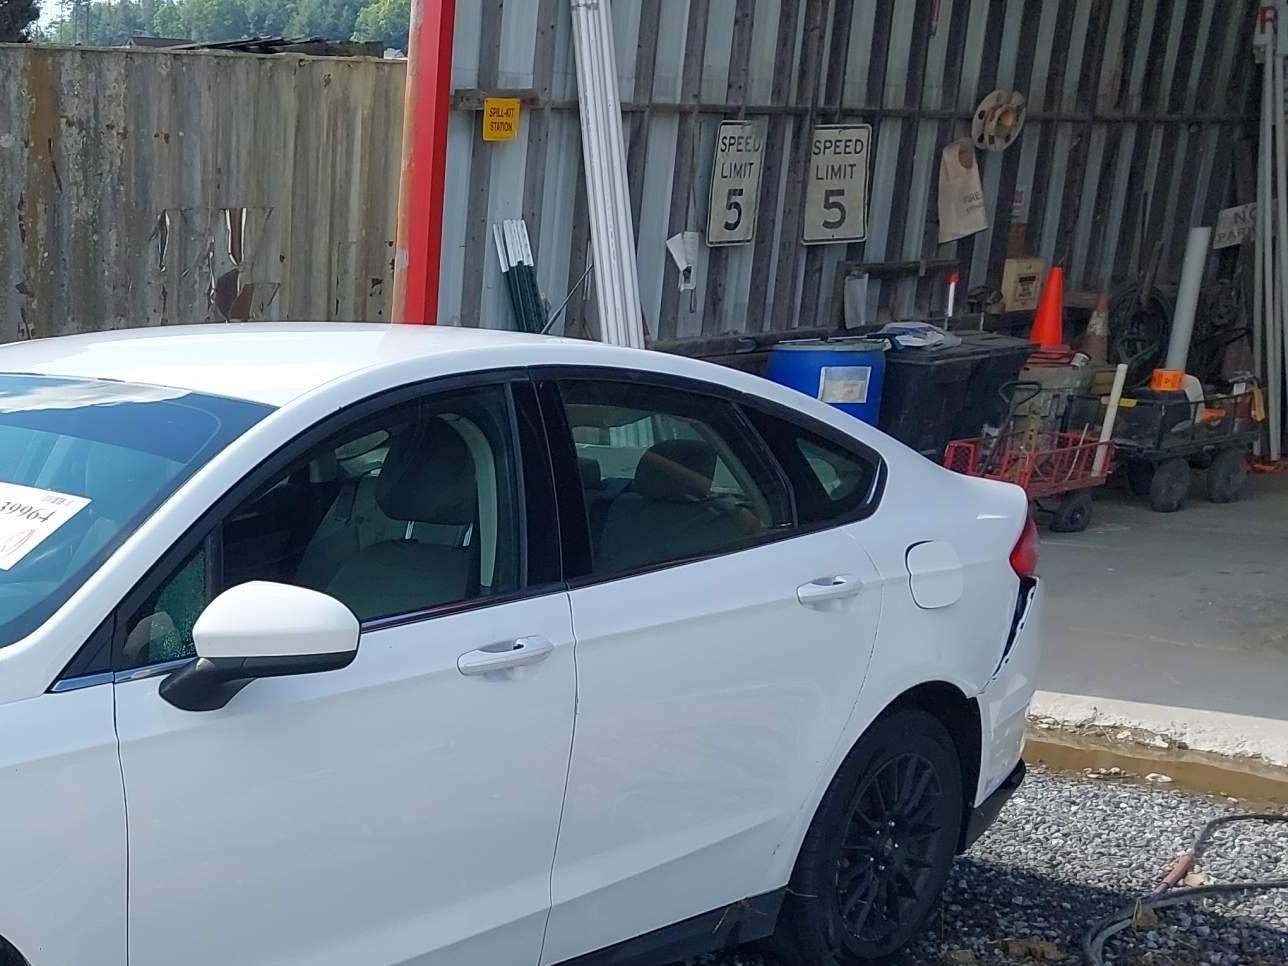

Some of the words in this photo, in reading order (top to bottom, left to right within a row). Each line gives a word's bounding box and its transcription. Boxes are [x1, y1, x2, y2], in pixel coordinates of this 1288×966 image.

[812, 139, 864, 156] SPEED
[721, 162, 754, 179] LIMIT
[815, 163, 857, 180] LIMIT
[723, 188, 744, 231] 5
[822, 189, 847, 229] 5
